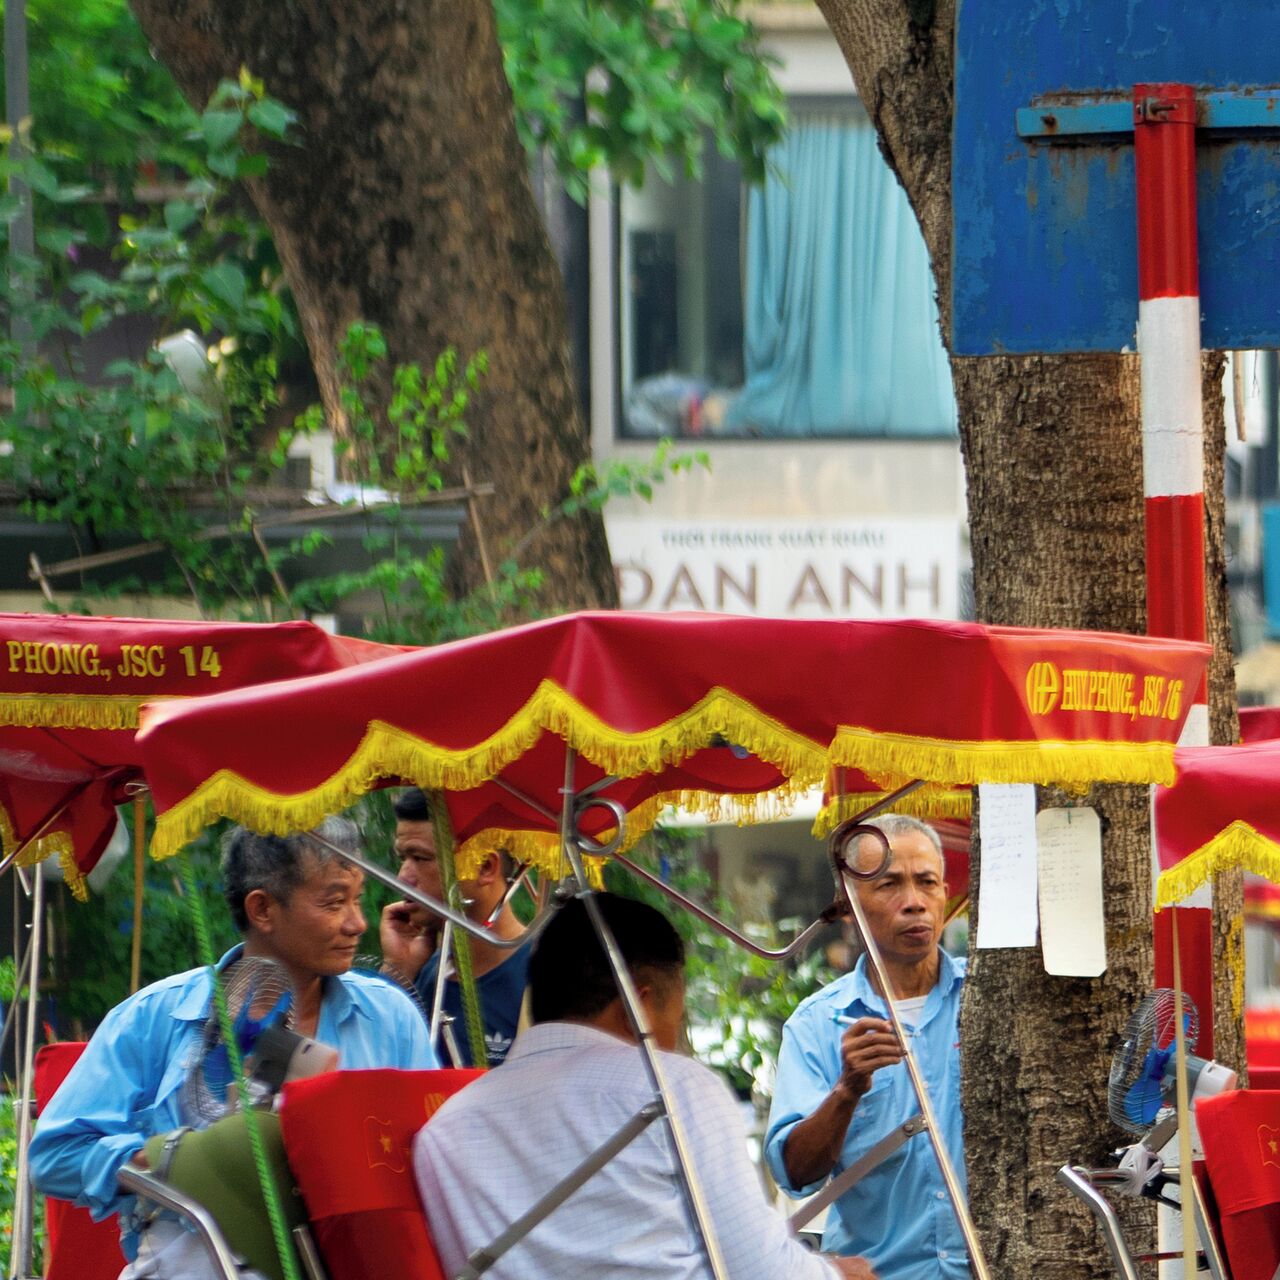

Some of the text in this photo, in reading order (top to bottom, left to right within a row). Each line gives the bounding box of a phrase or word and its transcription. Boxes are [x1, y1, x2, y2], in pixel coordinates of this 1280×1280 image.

[786, 560, 941, 613] ANH
[118, 645, 166, 677] JSC
[179, 646, 222, 677] 14
[1061, 670, 1089, 711] HUY
[1139, 675, 1165, 717] JSC
[1161, 680, 1184, 720] 16
